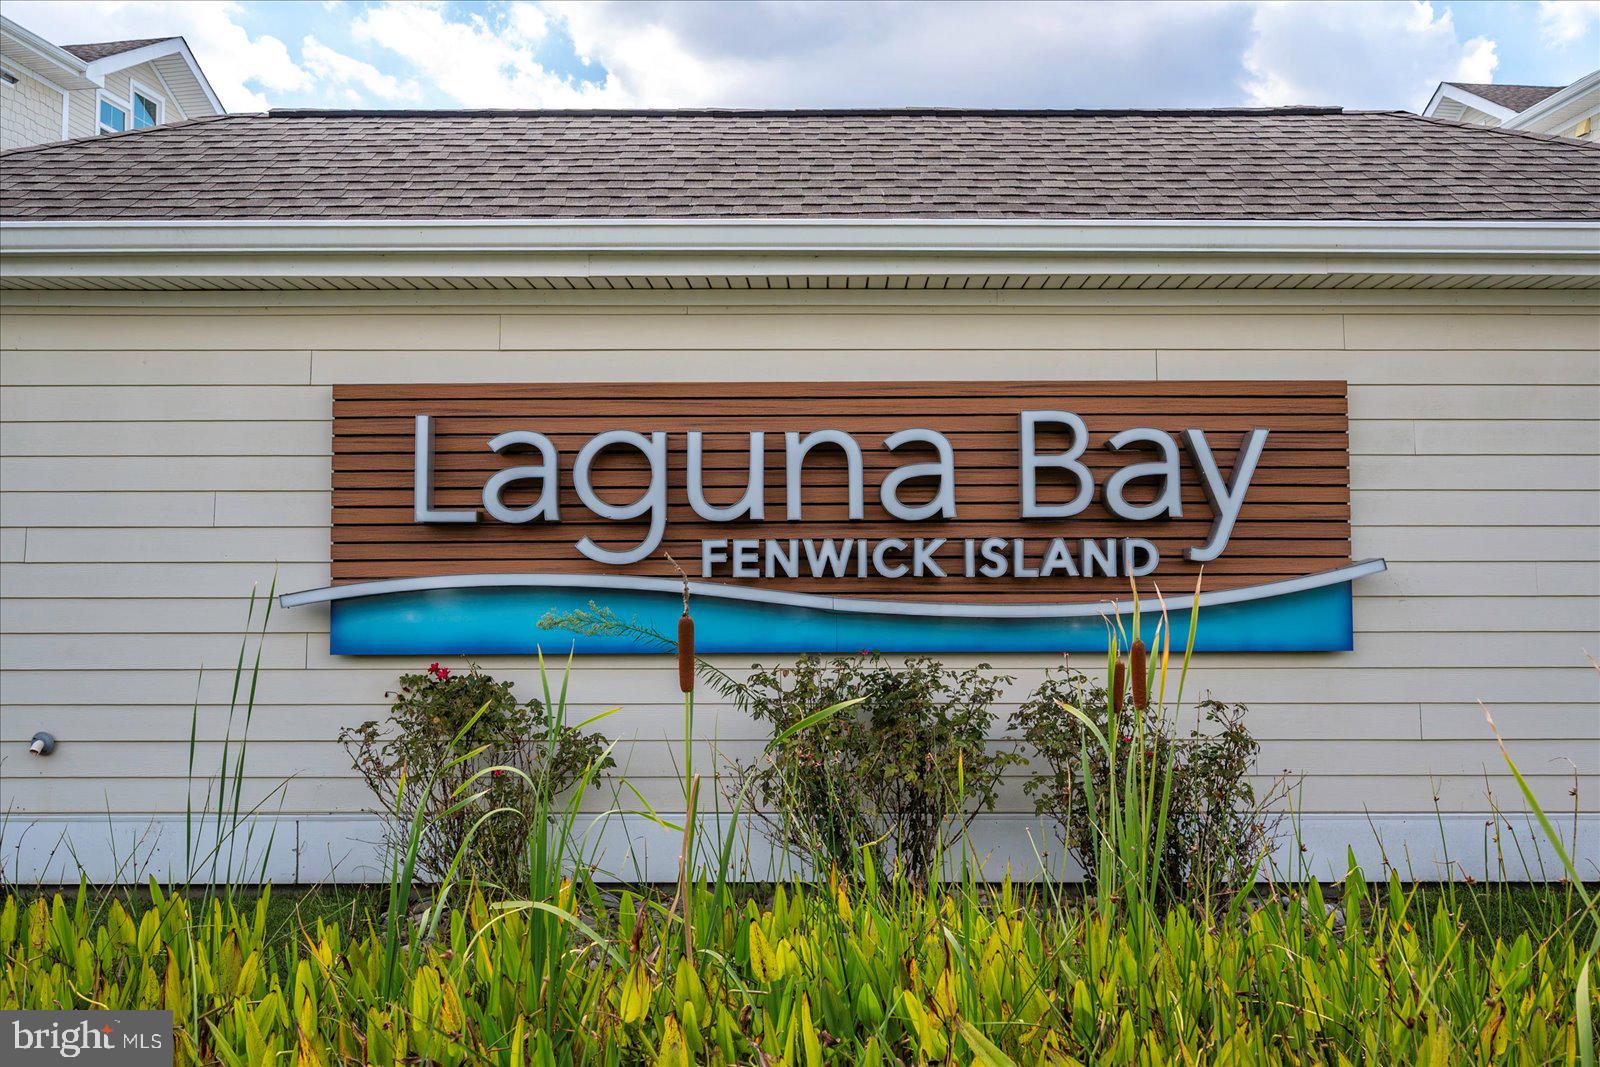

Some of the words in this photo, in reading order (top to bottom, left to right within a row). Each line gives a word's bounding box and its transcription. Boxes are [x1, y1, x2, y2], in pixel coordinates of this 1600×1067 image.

[414, 414, 957, 565] Laguna
[1020, 409, 1270, 563] Bay
[701, 537, 947, 578] FENWICK
[964, 536, 1160, 578] ISLAND
